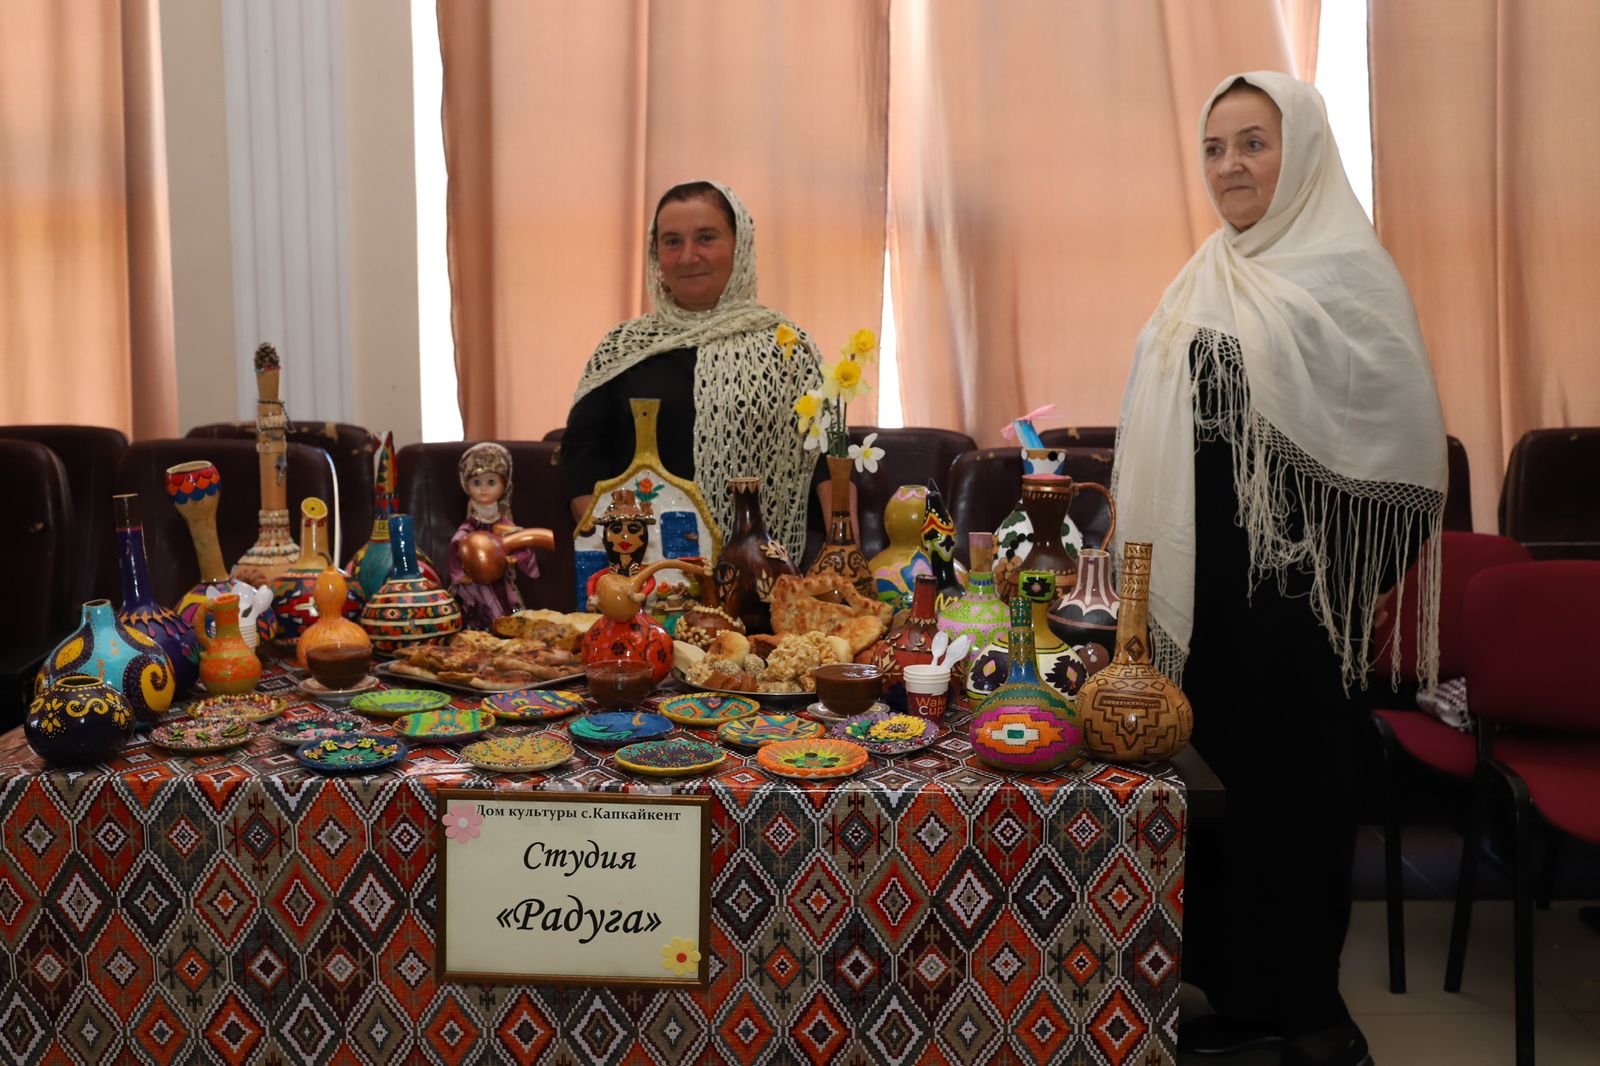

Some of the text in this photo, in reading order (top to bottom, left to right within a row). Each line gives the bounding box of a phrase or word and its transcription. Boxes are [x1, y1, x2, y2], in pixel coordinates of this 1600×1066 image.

[915, 696, 945, 707] Wak
[918, 705, 944, 717] Cup
[476, 804, 682, 822] Дом культуры с.Капкайкент
[523, 839, 637, 877] Студия
[496, 894, 662, 944] «Радуга»
